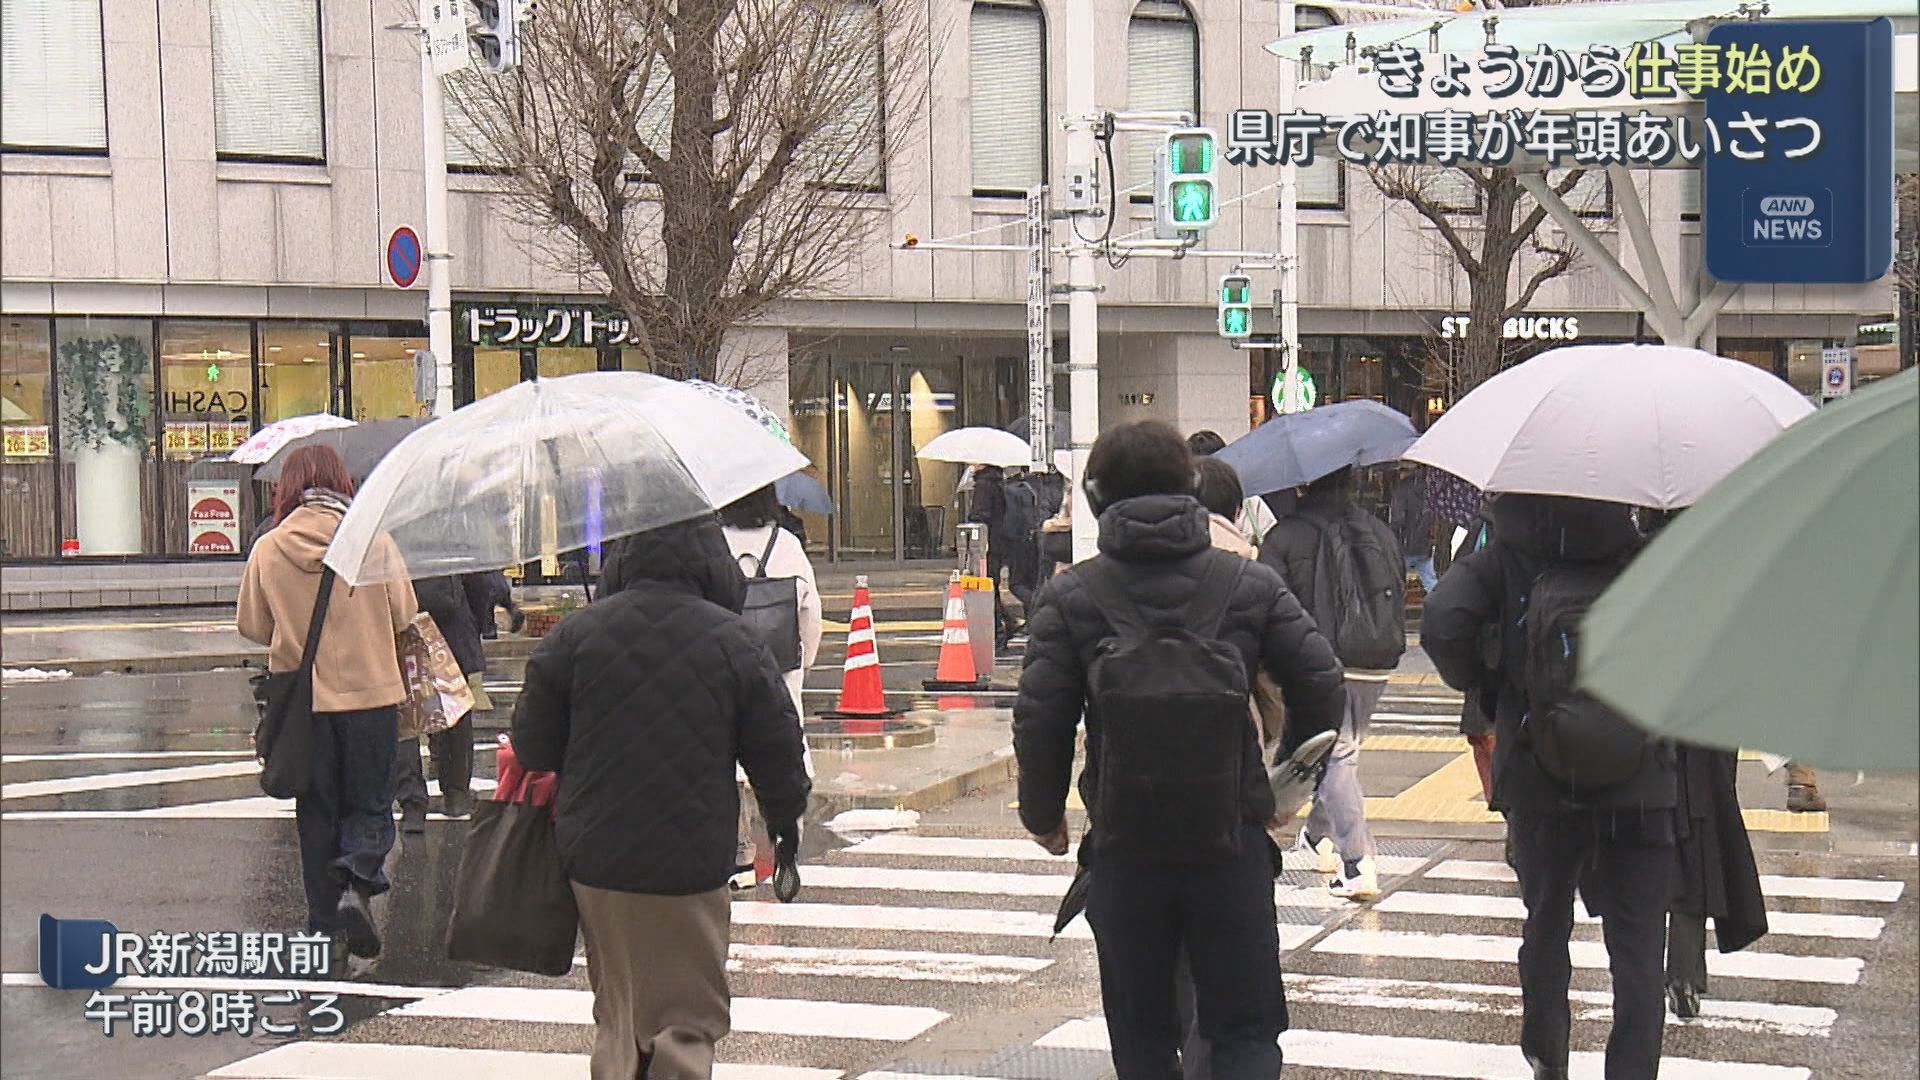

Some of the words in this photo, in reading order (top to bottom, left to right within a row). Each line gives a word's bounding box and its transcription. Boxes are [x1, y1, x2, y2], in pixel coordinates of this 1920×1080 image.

[469, 307, 640, 344] ドラッグトッ
[1441, 316, 1579, 340] STBUCKS
